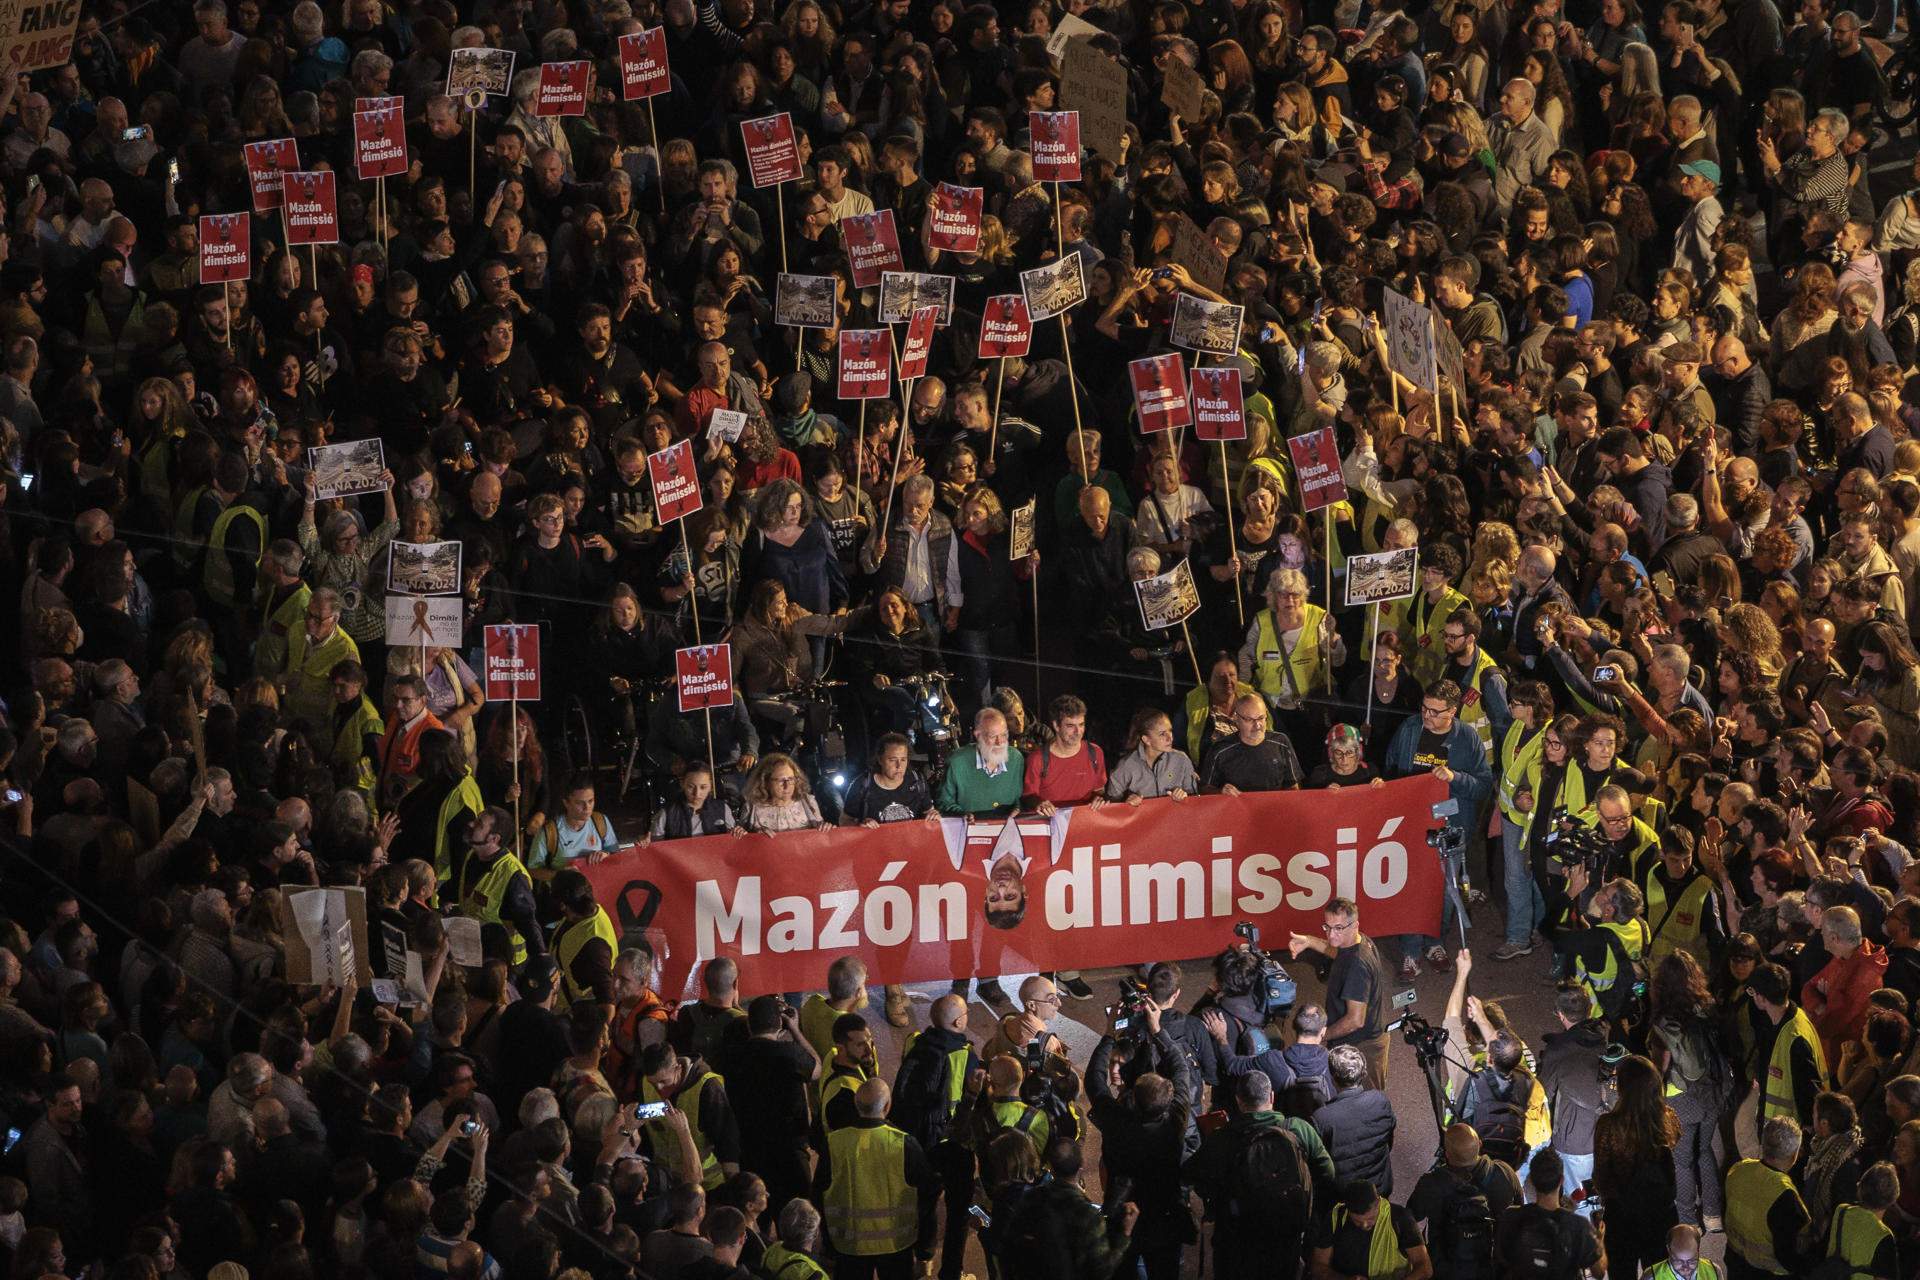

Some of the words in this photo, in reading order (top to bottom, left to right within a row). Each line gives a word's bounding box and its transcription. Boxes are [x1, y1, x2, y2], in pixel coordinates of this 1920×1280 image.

[19, 0, 76, 33] FANG
[10, 34, 73, 66] SANG
[625, 57, 656, 73] Mazón
[626, 65, 666, 85] dimissió
[542, 83, 574, 94] Mazón
[541, 93, 582, 103] dimissió
[360, 137, 391, 151] Mazón
[1034, 138, 1065, 152] Mazón
[361, 144, 403, 163] dimissió
[1035, 150, 1077, 165] dimissió
[289, 201, 321, 214] Mazón
[290, 213, 334, 226] dimissió
[936, 209, 967, 222] Mazón
[933, 221, 977, 236] dimissió
[204, 242, 236, 255] Mazón
[851, 241, 885, 257] Mazón
[204, 252, 247, 267] dimissió
[855, 250, 898, 270] dimissió
[804, 312, 831, 323] 2024
[986, 320, 1018, 332] Mazón
[984, 331, 1027, 342] dimissió
[1204, 337, 1234, 351] 2024
[843, 358, 877, 369] Mazón
[843, 368, 887, 382] dimissió
[1197, 397, 1229, 410] Mazón
[1199, 407, 1241, 422] dimissió
[1300, 463, 1329, 479] Mazón
[656, 474, 687, 494] Mazón
[1303, 473, 1341, 492] dimissió
[659, 480, 697, 506] dimissió
[429, 579, 456, 590] 2024
[1351, 586, 1386, 599] DANA
[1386, 582, 1411, 595] 2024
[1148, 606, 1183, 623] DANA
[489, 655, 524, 667] Mazón
[490, 668, 536, 681] dimissió
[682, 671, 716, 685] Mazón
[683, 679, 728, 695] dimissió
[694, 860, 968, 961] Mazón
[1044, 815, 1409, 932] dimissió
